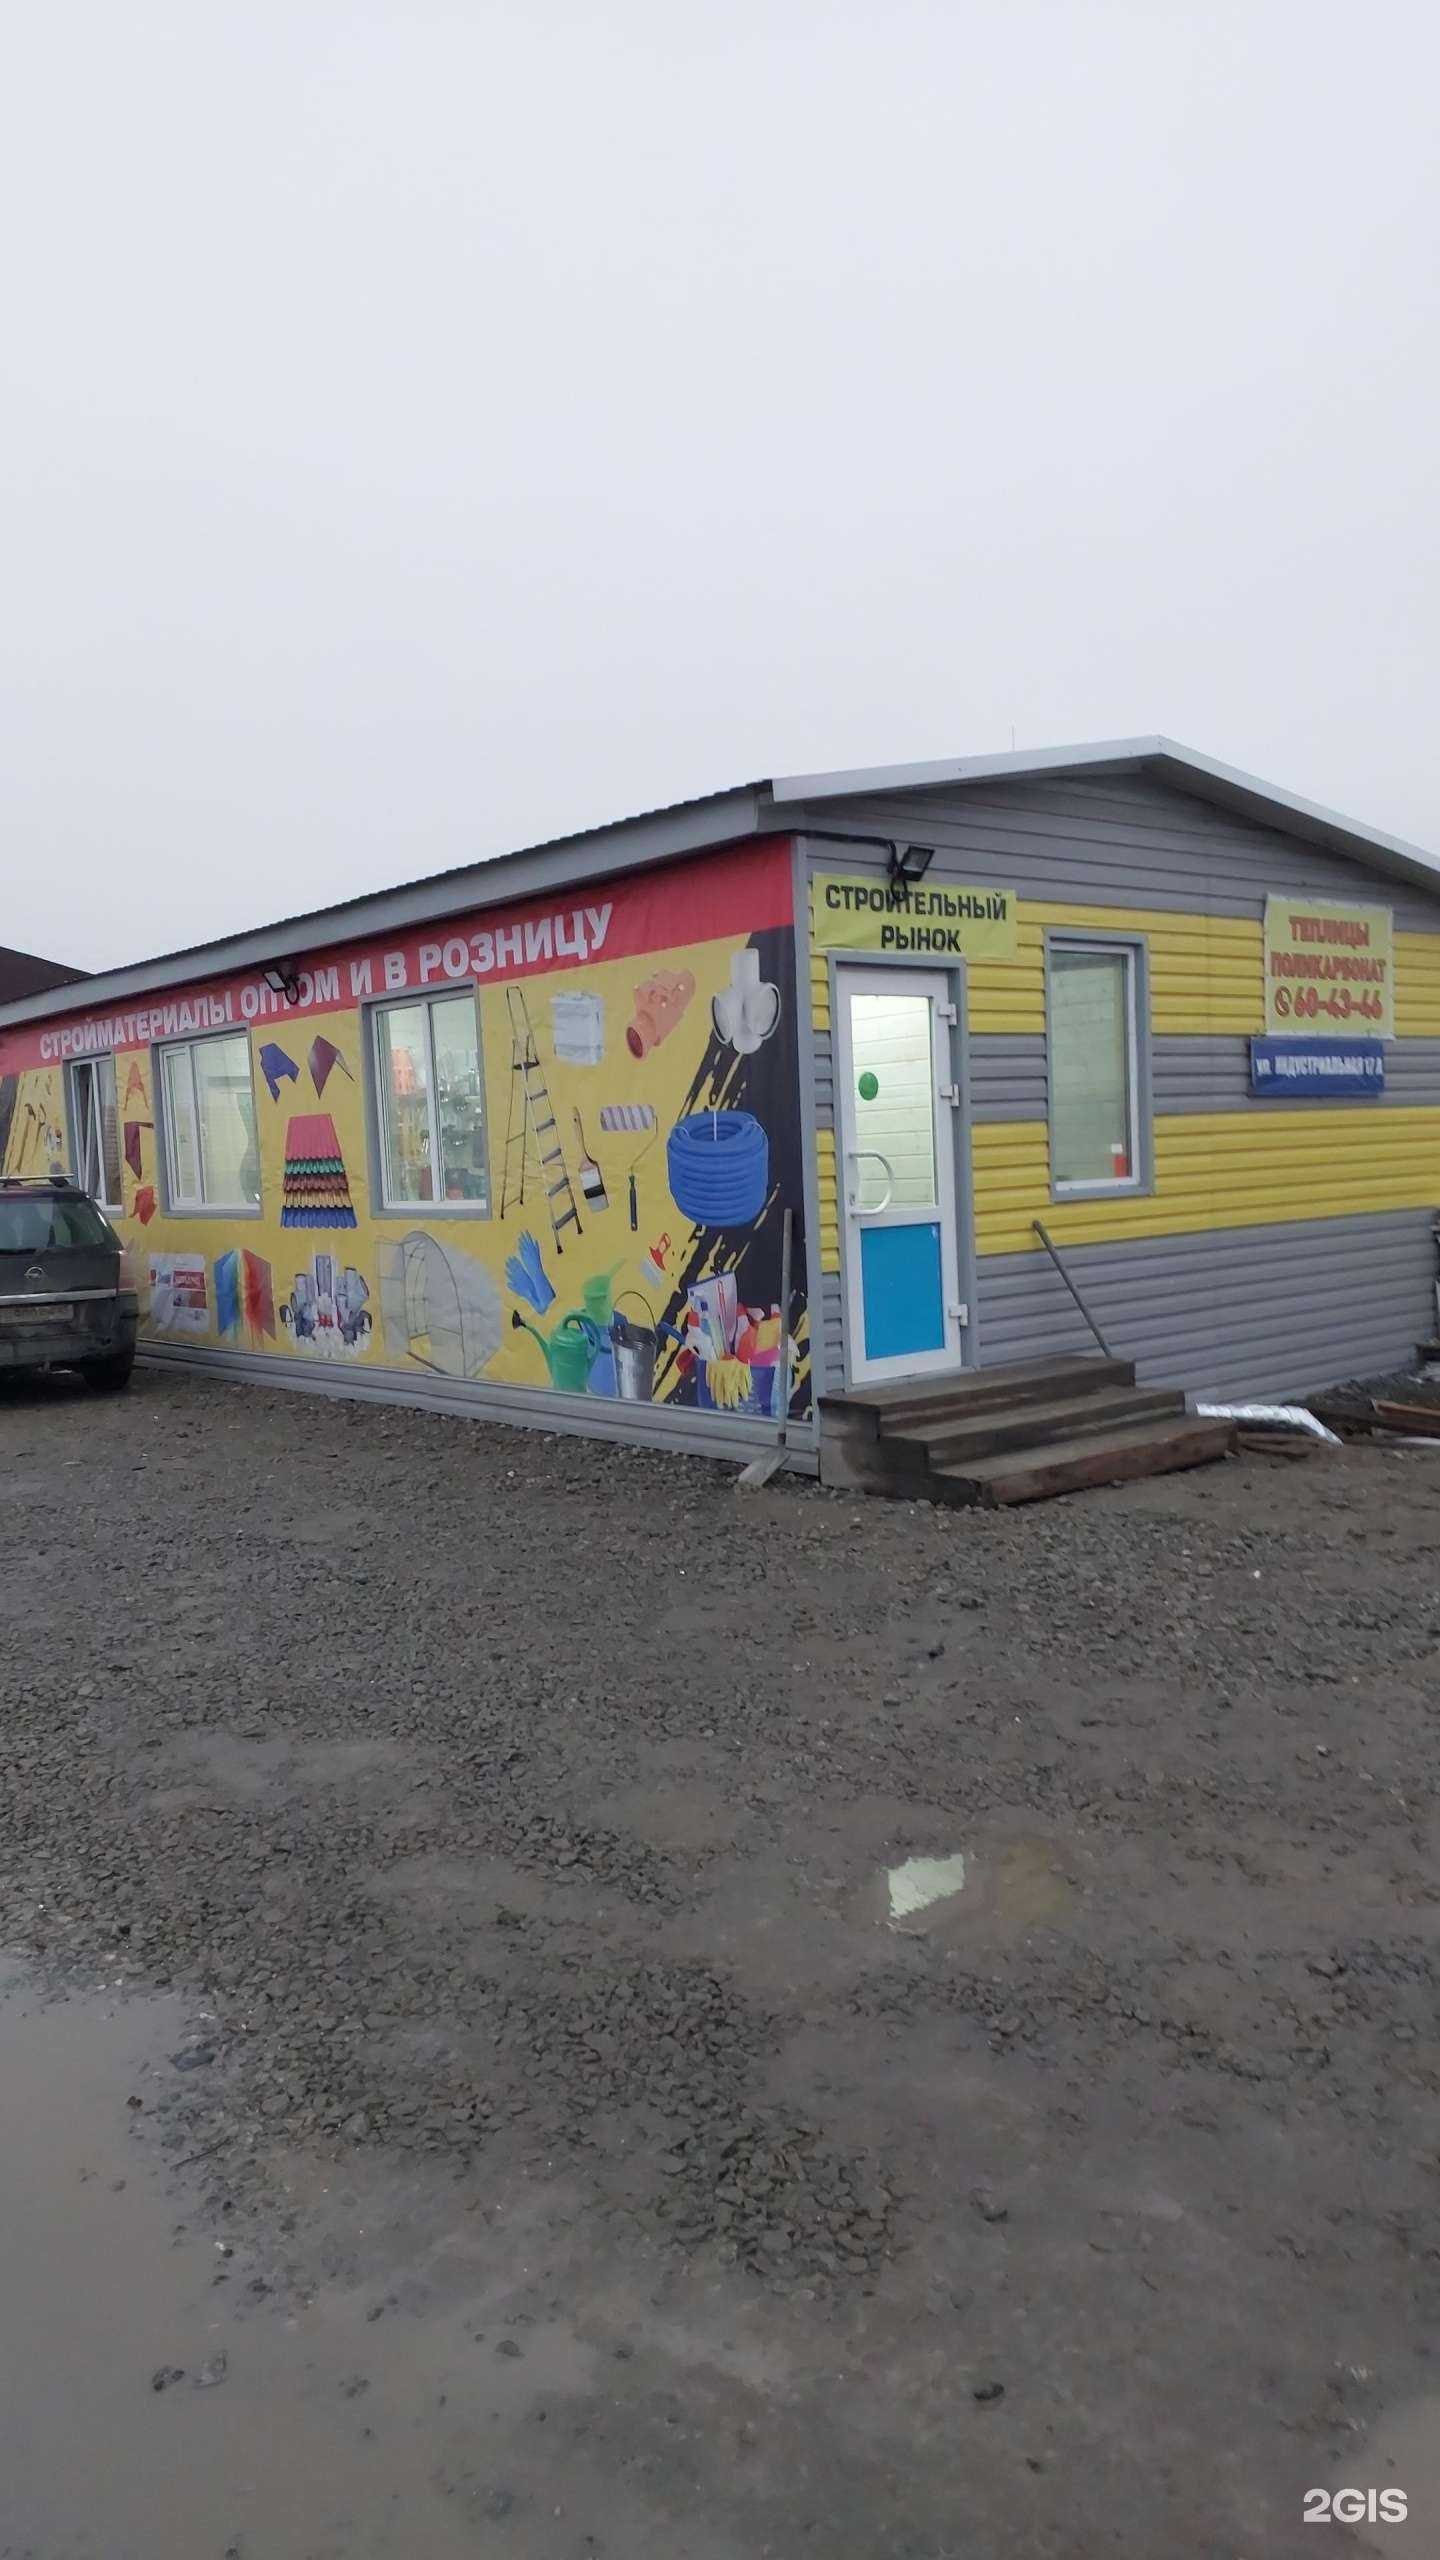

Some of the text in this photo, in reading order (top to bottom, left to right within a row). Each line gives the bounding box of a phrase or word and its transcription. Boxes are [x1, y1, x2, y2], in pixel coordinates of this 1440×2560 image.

[825, 884, 1007, 921] СТРОИТЕЛЬНЫЙ
[881, 925, 962, 952] РЫНОК
[39, 991, 233, 1060] СТРОЙМАТЕРИАЛЫ
[351, 959, 373, 997] И
[383, 951, 408, 990] В
[418, 902, 614, 983] РОЗНИЦУ
